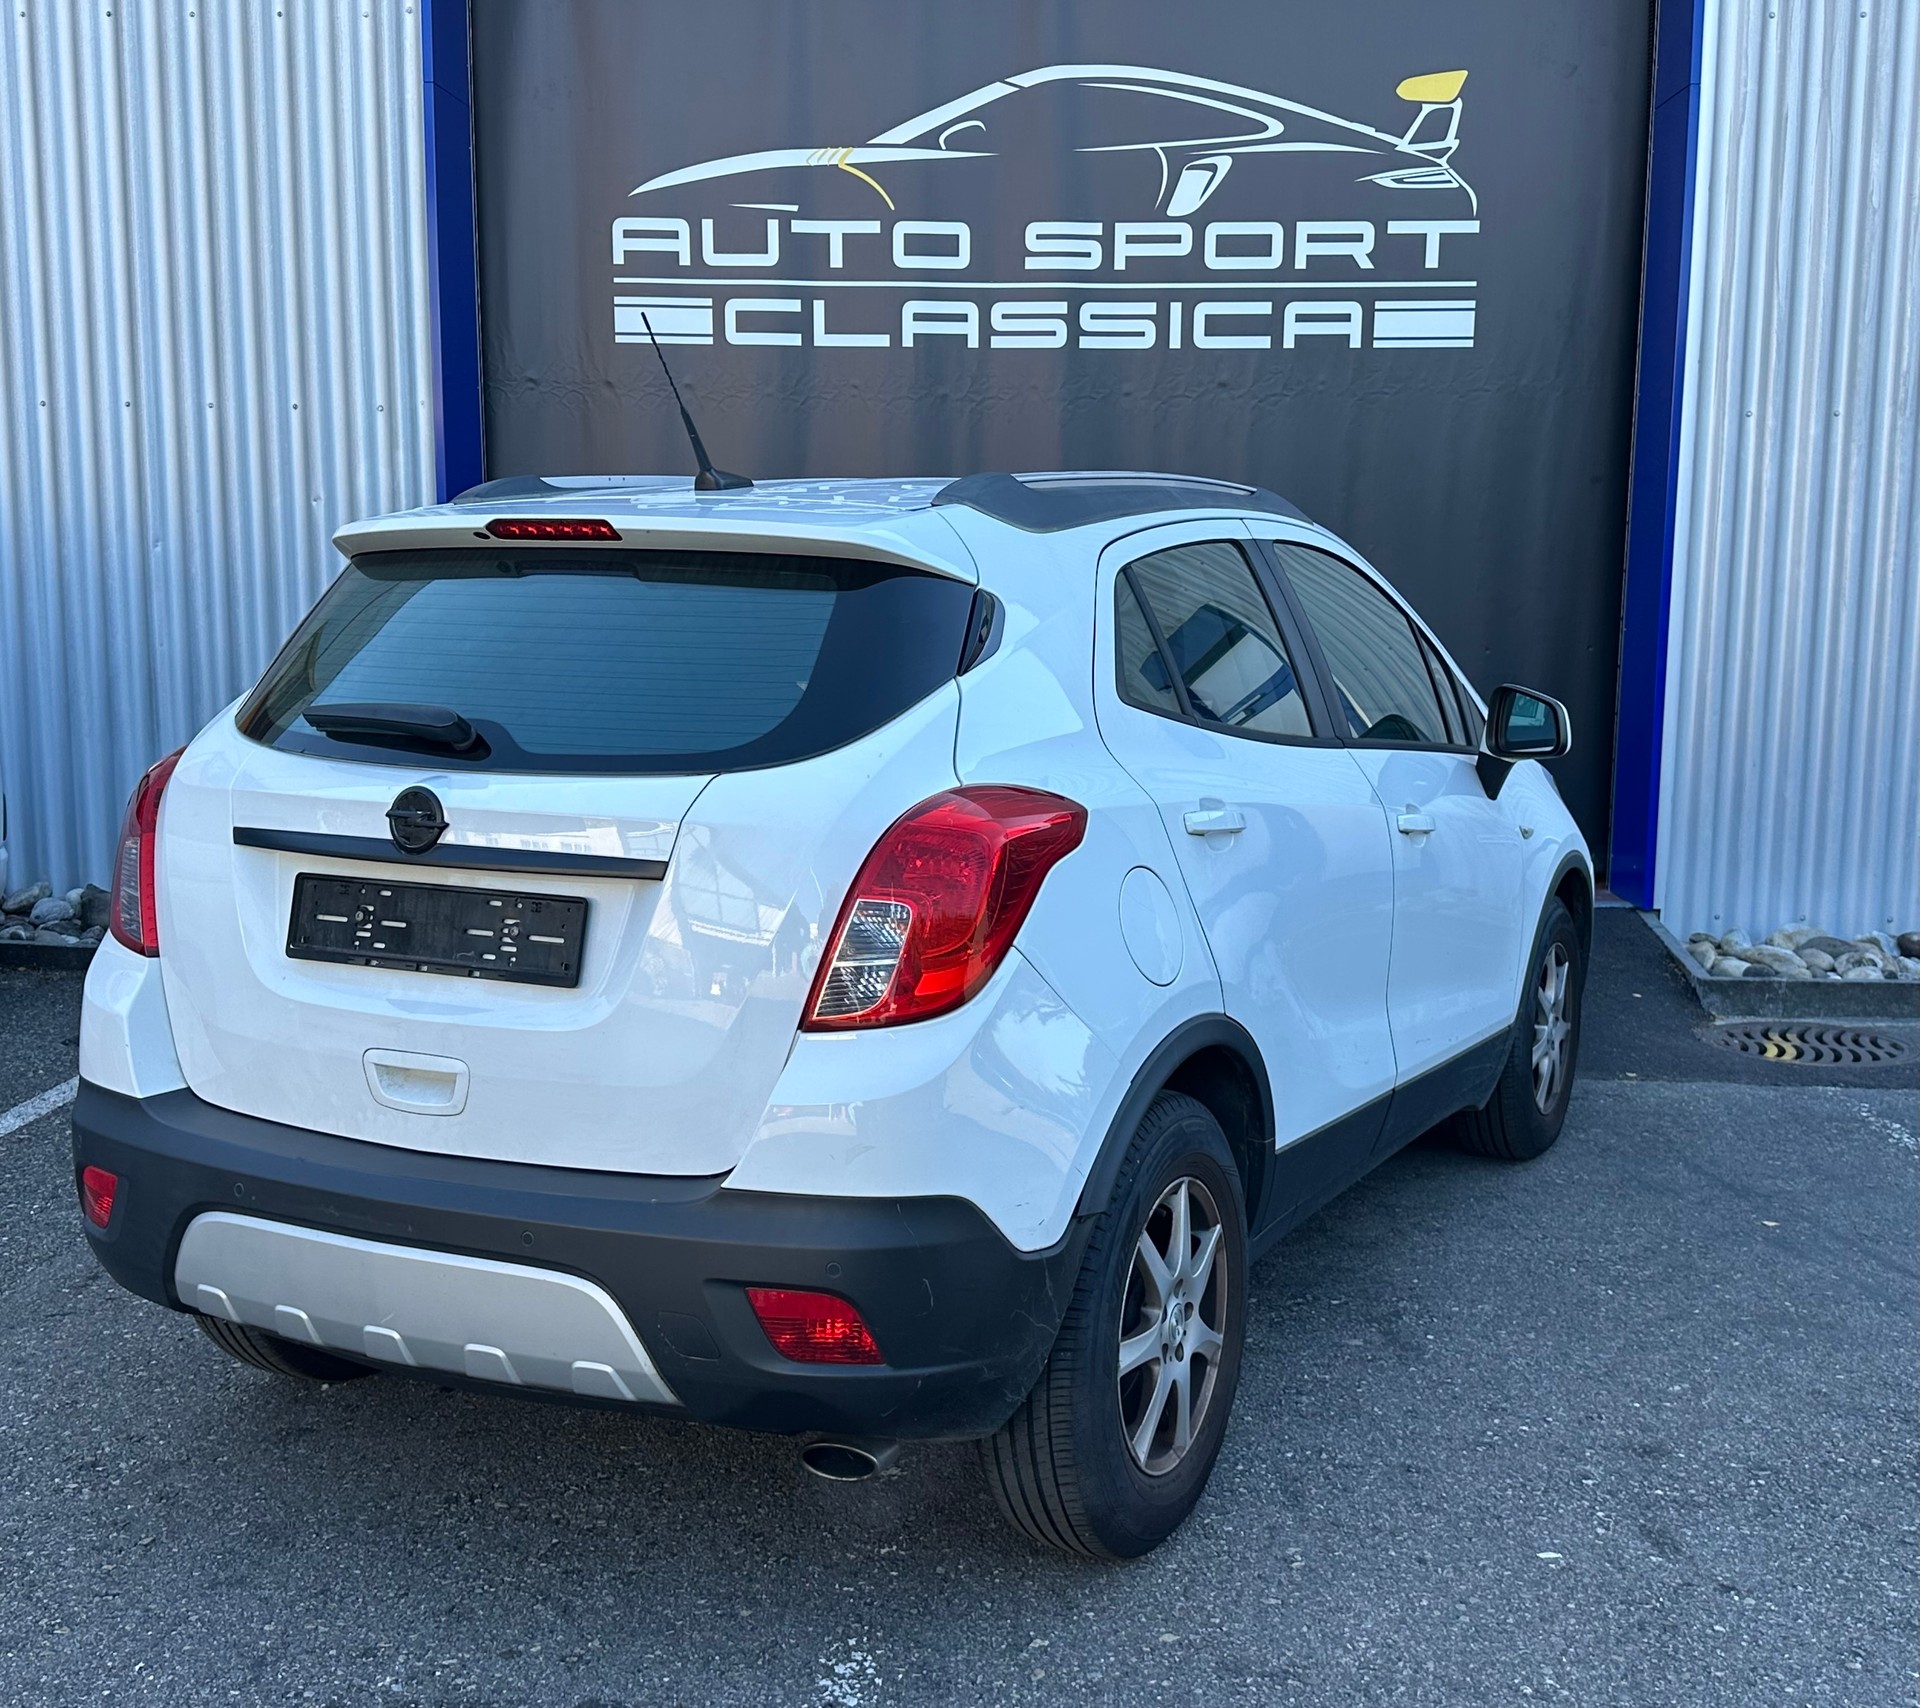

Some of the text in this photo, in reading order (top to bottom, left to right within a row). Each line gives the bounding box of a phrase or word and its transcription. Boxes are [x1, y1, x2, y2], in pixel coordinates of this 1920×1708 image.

[611, 216, 1481, 271] AUTO SPORT
[723, 298, 1364, 350] CLASSICA
